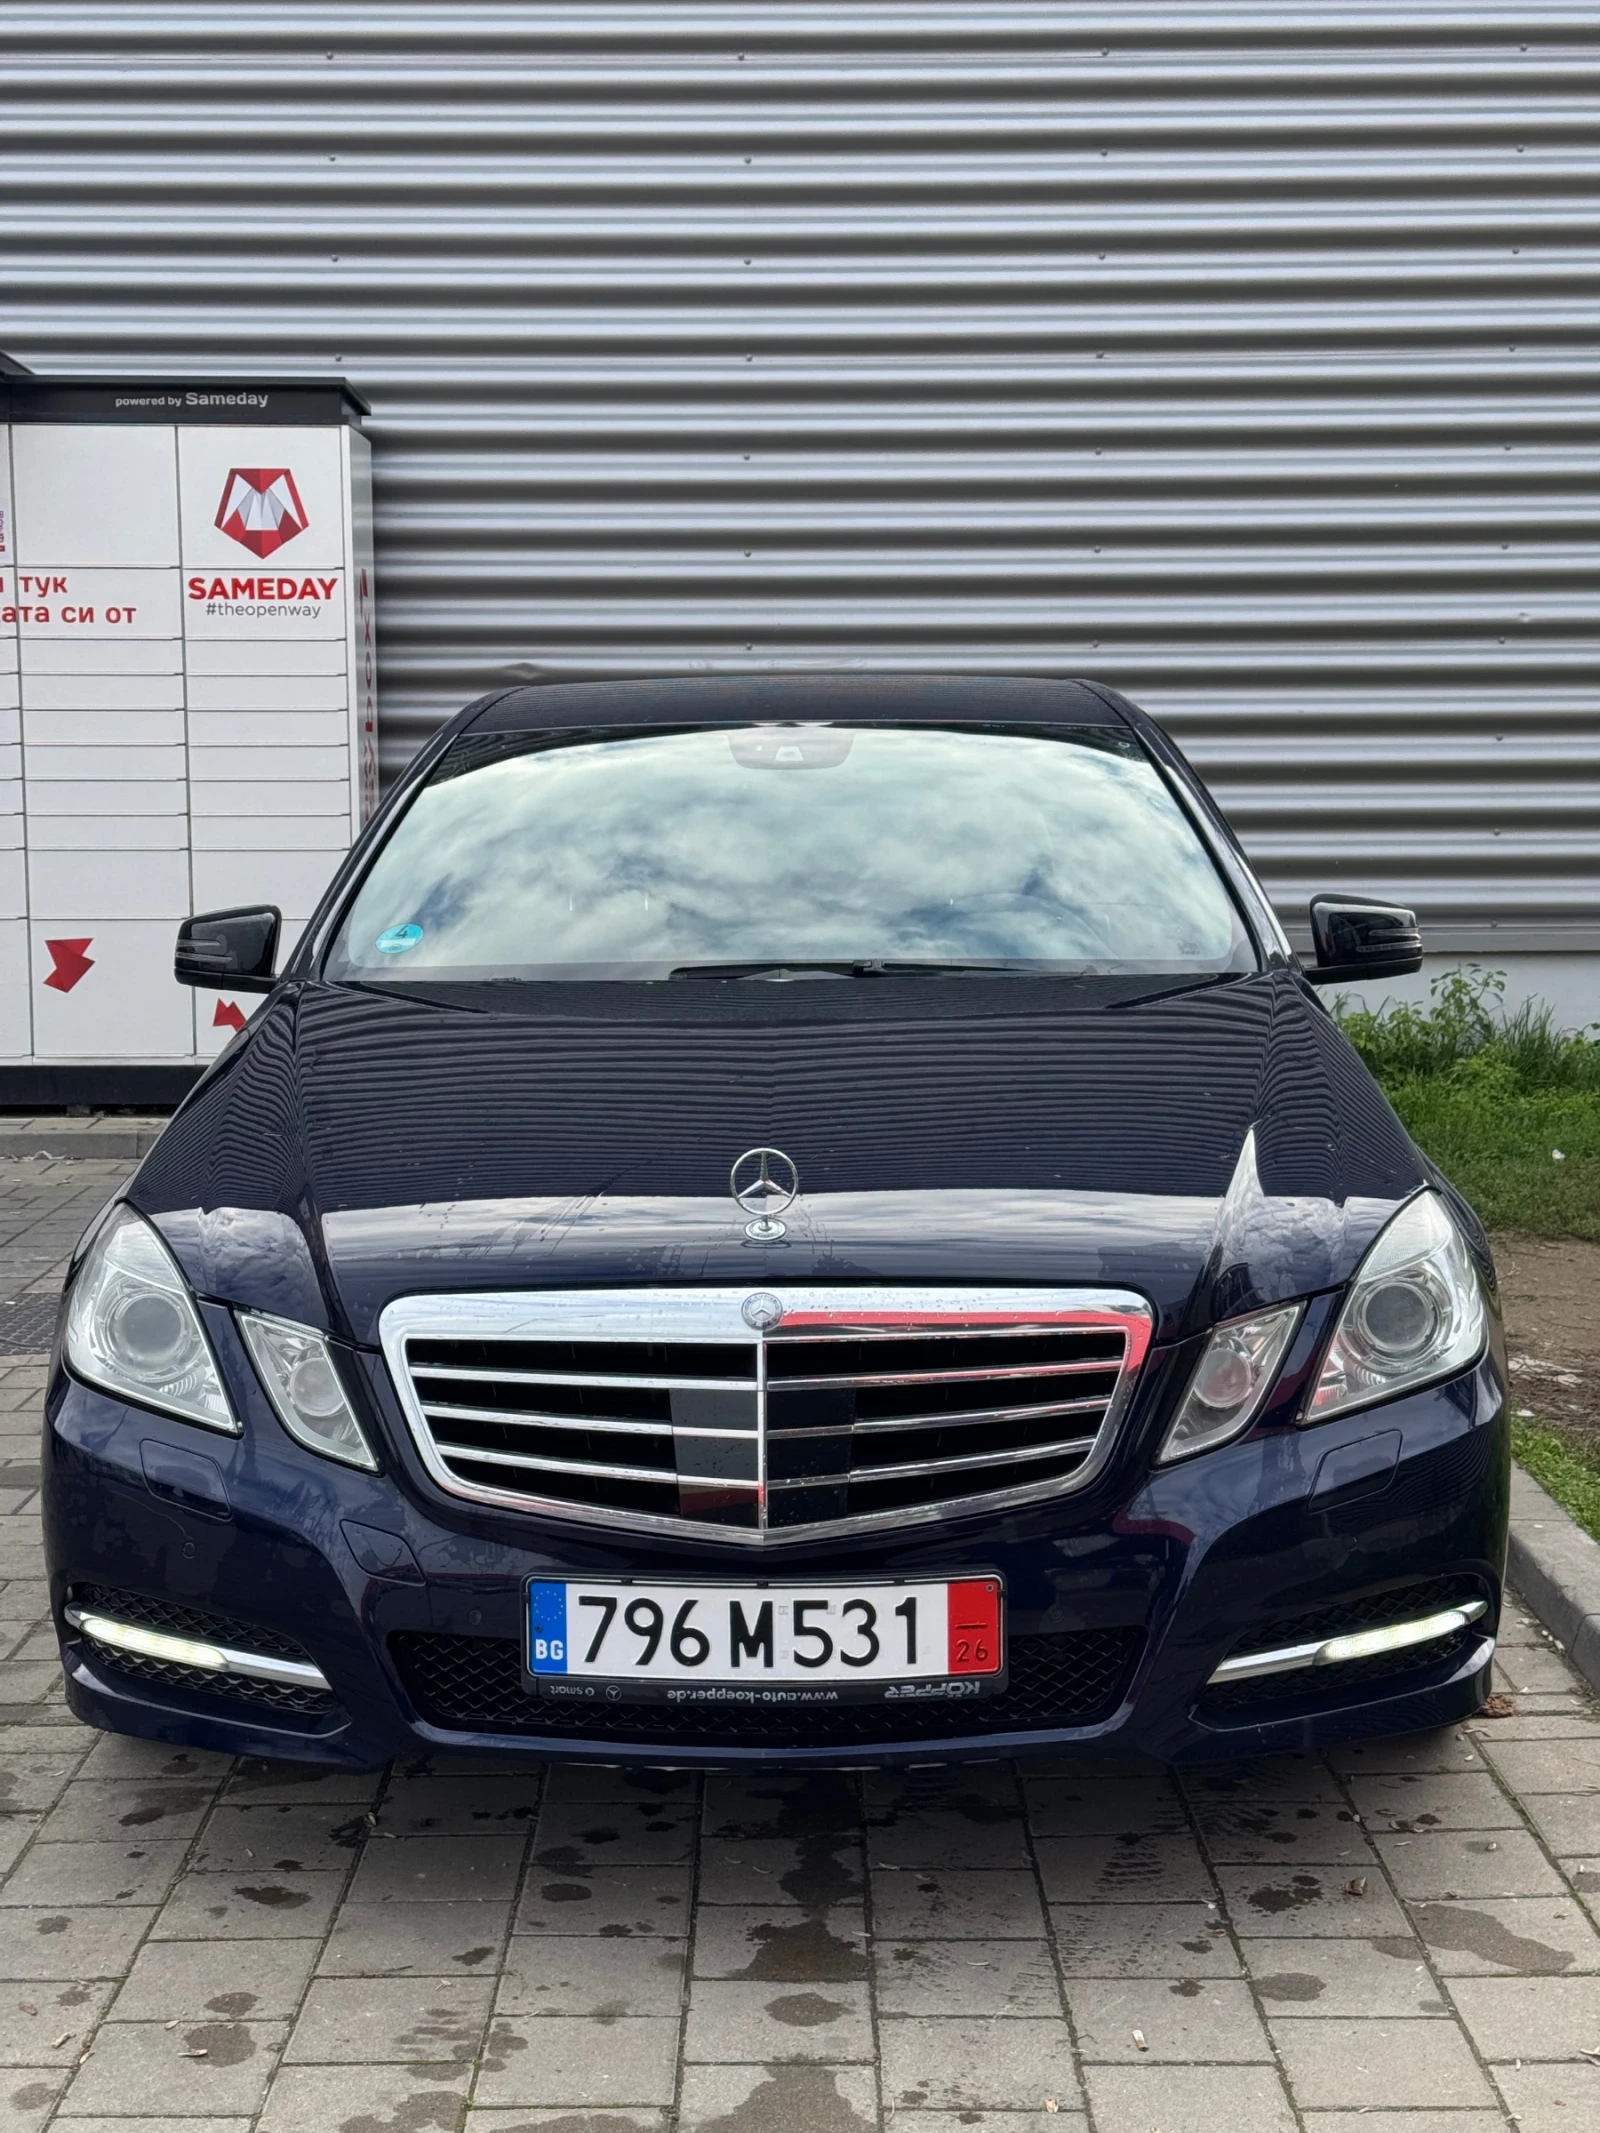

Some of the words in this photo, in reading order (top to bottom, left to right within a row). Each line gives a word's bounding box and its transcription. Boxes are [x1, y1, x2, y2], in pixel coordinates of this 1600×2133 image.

[115, 397, 165, 407] powered
[168, 396, 182, 407] by
[185, 392, 269, 408] Sameday
[19, 576, 68, 598] тук
[188, 577, 338, 600] SAMEDAY
[0, 606, 50, 623] ата
[61, 606, 95, 623] си
[105, 607, 137, 623] от
[206, 602, 321, 618] #theopenway
[394, 924, 408, 938] 4
[578, 1596, 710, 1667] 796
[729, 1600, 774, 1668] M
[793, 1596, 917, 1668] 531
[535, 1639, 564, 1661] BG
[956, 1639, 989, 1663] 26
[550, 1685, 583, 1696] smart
[667, 1687, 838, 1703] www.auto-koepper.de
